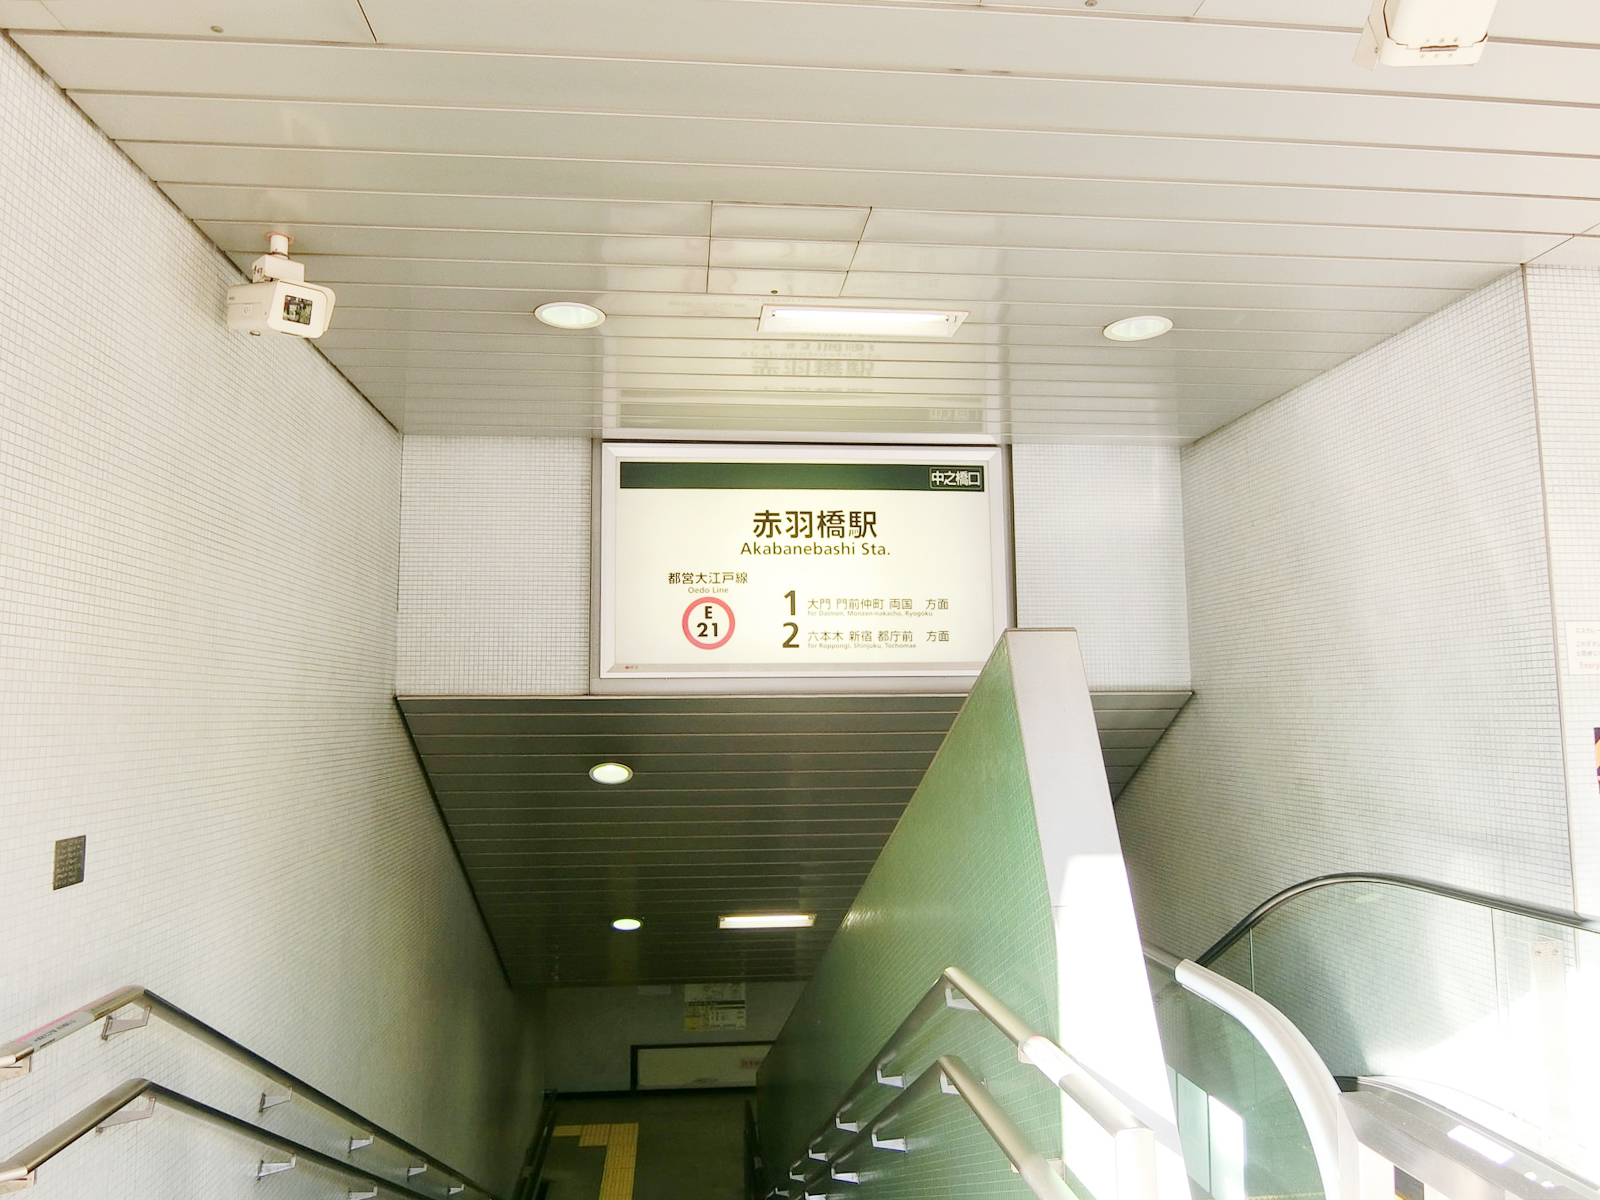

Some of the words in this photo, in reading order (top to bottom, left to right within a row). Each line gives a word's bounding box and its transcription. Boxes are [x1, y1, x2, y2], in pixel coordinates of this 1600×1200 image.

[931, 470, 980, 487] 中之橋口
[753, 510, 877, 539] 赤羽橋駅
[741, 542, 855, 555] Akabanebashi
[862, 542, 890, 555] Sta.
[668, 572, 748, 584] 都営大江戸線
[784, 590, 796, 616] 1
[807, 598, 831, 610] 大門
[836, 598, 883, 610] 門前仲町
[889, 598, 912, 610] 両国
[925, 598, 949, 610] 方面
[704, 605, 713, 619] E
[697, 622, 718, 637] 21
[782, 621, 800, 648] 2
[808, 631, 844, 642] 六本木
[849, 631, 873, 642] 新宿
[878, 631, 913, 642] 都庁前
[926, 631, 950, 642] 方面
[853, 642, 883, 650] Shinjuku,
